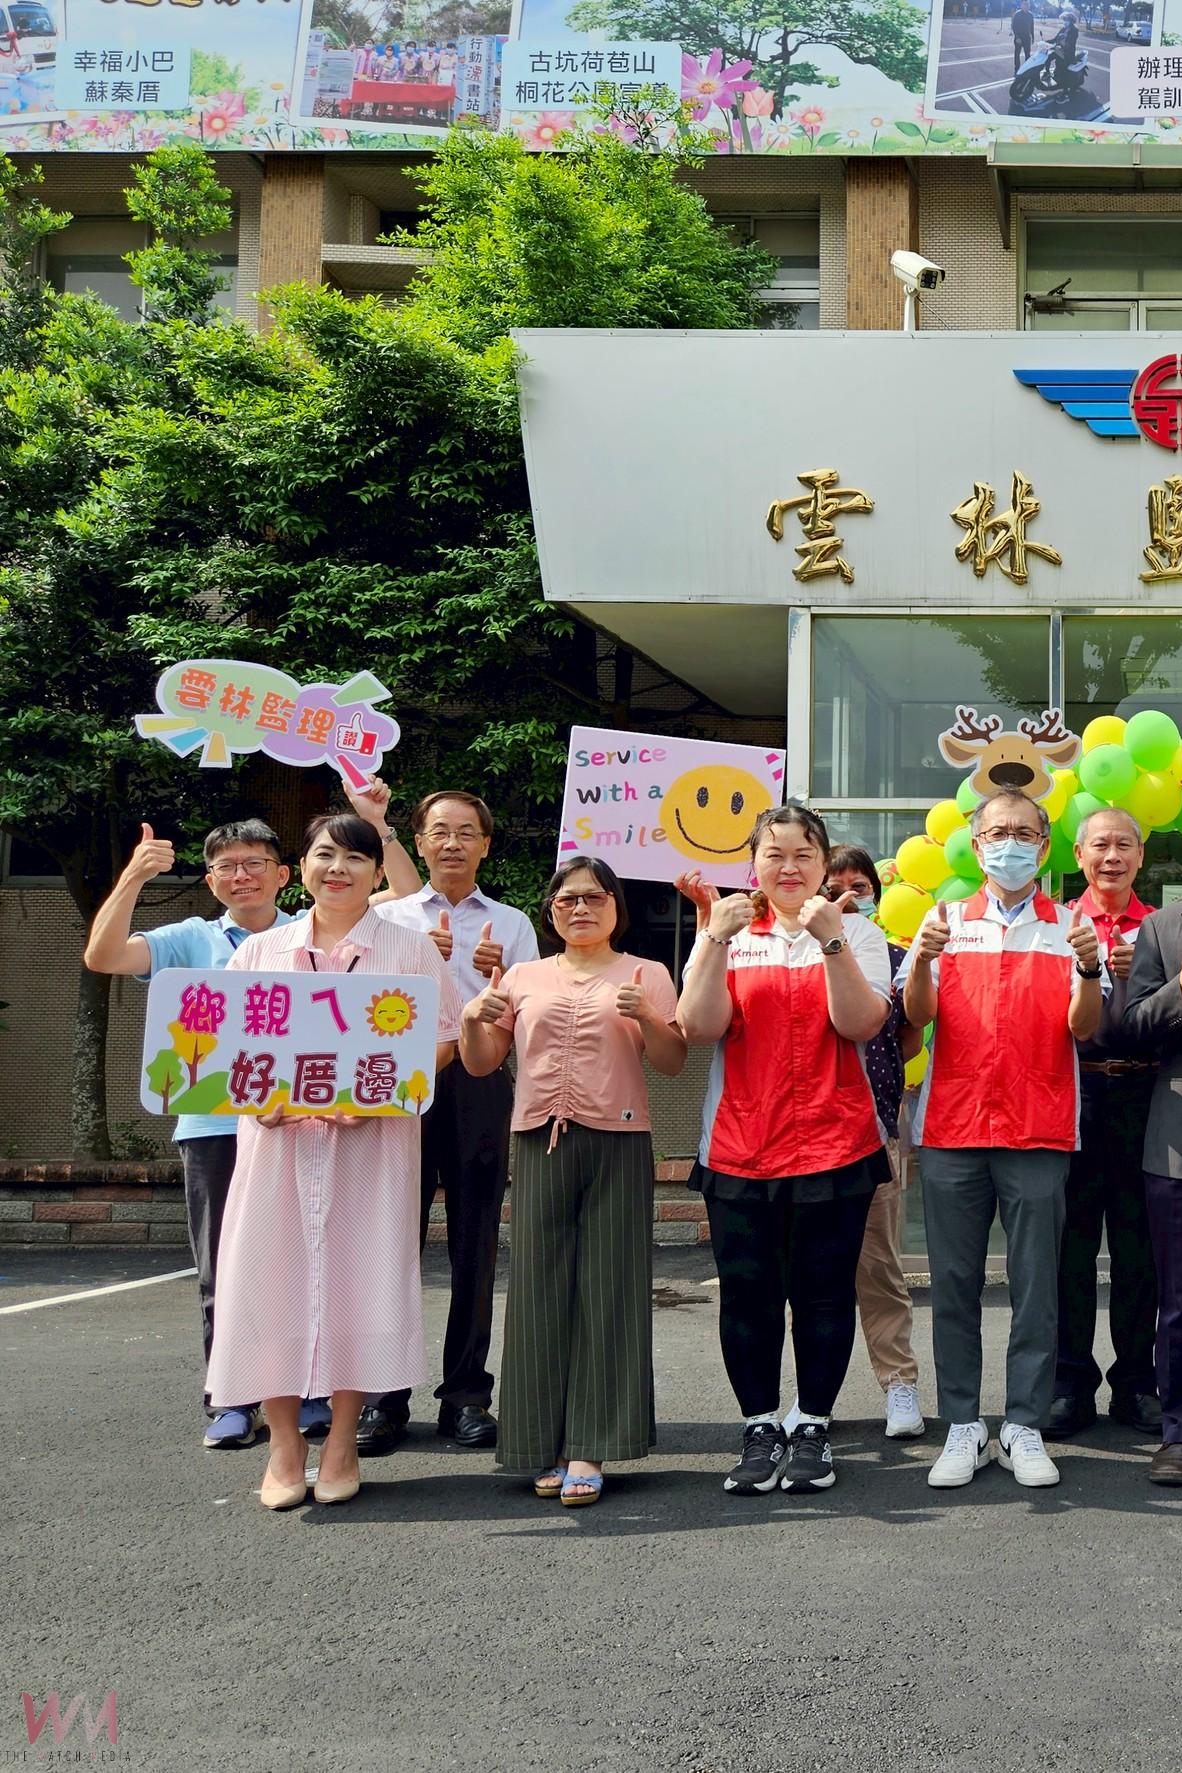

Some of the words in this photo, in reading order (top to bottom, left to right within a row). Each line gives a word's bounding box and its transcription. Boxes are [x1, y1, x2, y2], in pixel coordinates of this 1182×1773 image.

[74, 50, 174, 73] 幸福小巴
[529, 51, 656, 74] 古坑荷苞山
[85, 80, 161, 103] 蘇秦厝
[174, 667, 337, 746] 雲林監理
[576, 781, 639, 804] with
[648, 784, 664, 799] a
[575, 816, 668, 848] Smile
